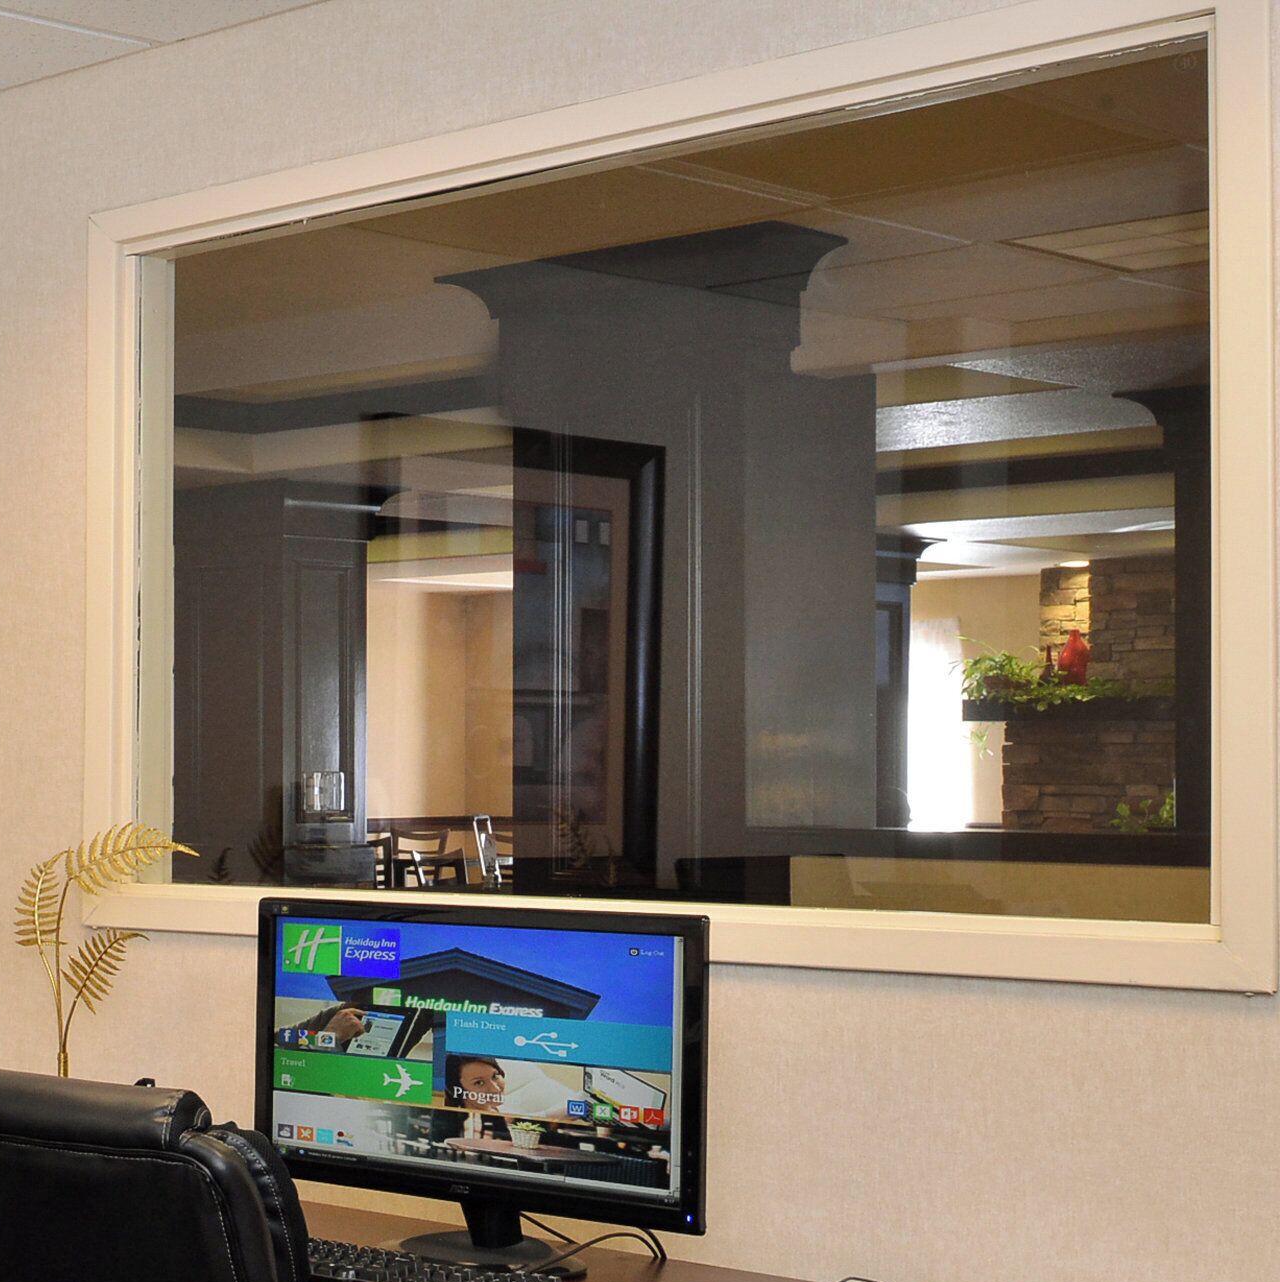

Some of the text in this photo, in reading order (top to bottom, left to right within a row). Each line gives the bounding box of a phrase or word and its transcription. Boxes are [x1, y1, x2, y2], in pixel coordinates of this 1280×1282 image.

[345, 936, 397, 949] Holiday Inn
[344, 947, 396, 962] Express
[463, 1000, 487, 1014] Inn
[453, 1018, 507, 1031] Flash Drive
[280, 1056, 306, 1067] Travel
